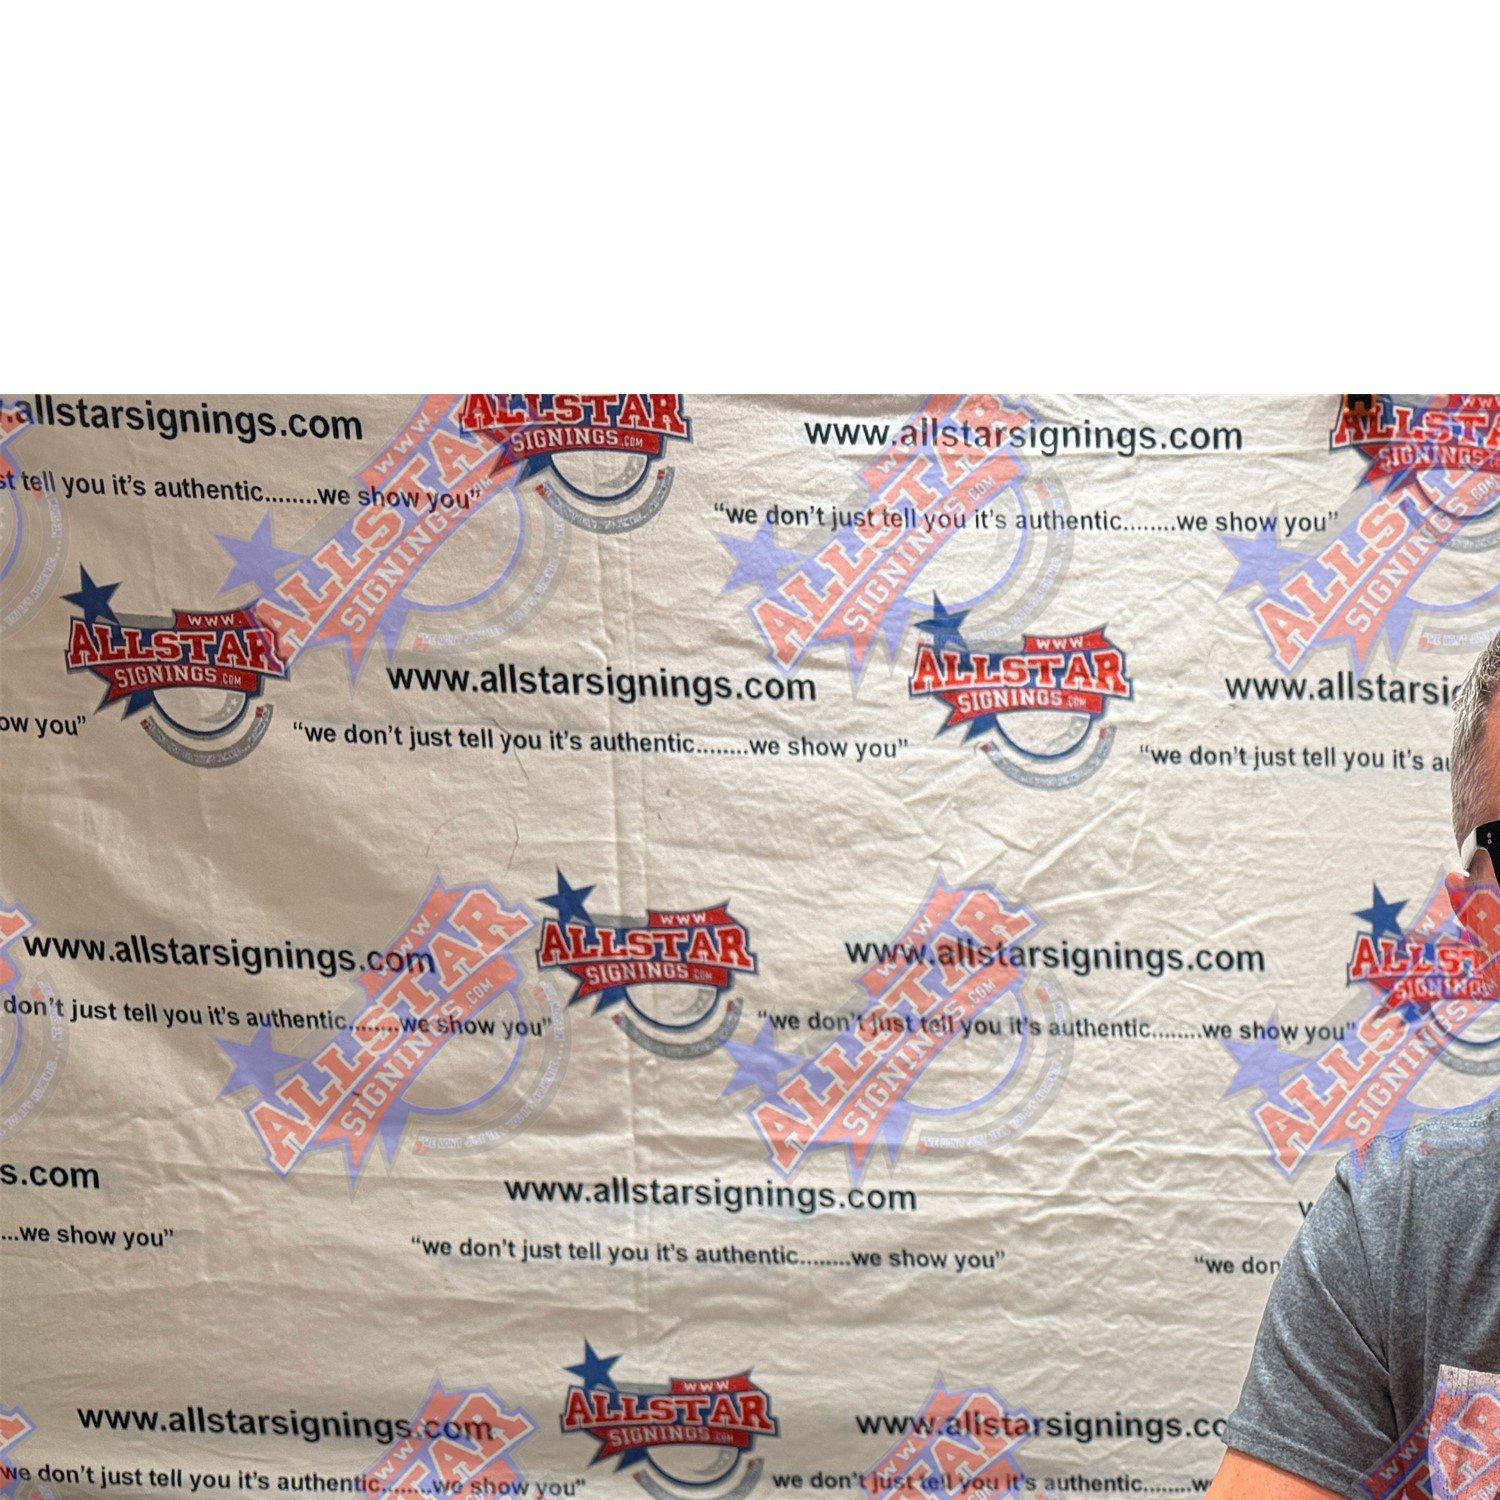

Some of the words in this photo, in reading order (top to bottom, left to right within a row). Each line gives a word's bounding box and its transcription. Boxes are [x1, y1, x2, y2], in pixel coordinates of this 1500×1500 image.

[511, 428, 618, 450] SIGNINGS
[804, 417, 1242, 457] www.allstarsignings.com
[67, 621, 287, 673] ALLSTAR
[113, 665, 218, 687] SIGNINGS
[386, 664, 816, 706] www.allstarsignings.com
[909, 651, 1133, 697] ALLSTAR
[957, 688, 1064, 713] SIGNINGS
[409, 726, 452, 751] just
[458, 729, 493, 748] tell
[500, 733, 541, 754] you
[788, 734, 848, 757] show
[22, 935, 436, 978] www.allstarsignings.com
[539, 925, 756, 974] ALLSTAR
[845, 938, 1265, 977] www.allstarsignings.com
[586, 961, 689, 983] SIGNINGS
[504, 1177, 916, 1215] www.allstarsignings.com
[521, 1239, 562, 1264] just
[568, 1242, 601, 1260] tell
[608, 1246, 649, 1266] you
[888, 1248, 947, 1268] show
[77, 1406, 496, 1446] www.allstarsignings.com
[563, 1389, 778, 1437] ALLSTAR
[607, 1424, 710, 1448] SIGNINGS
